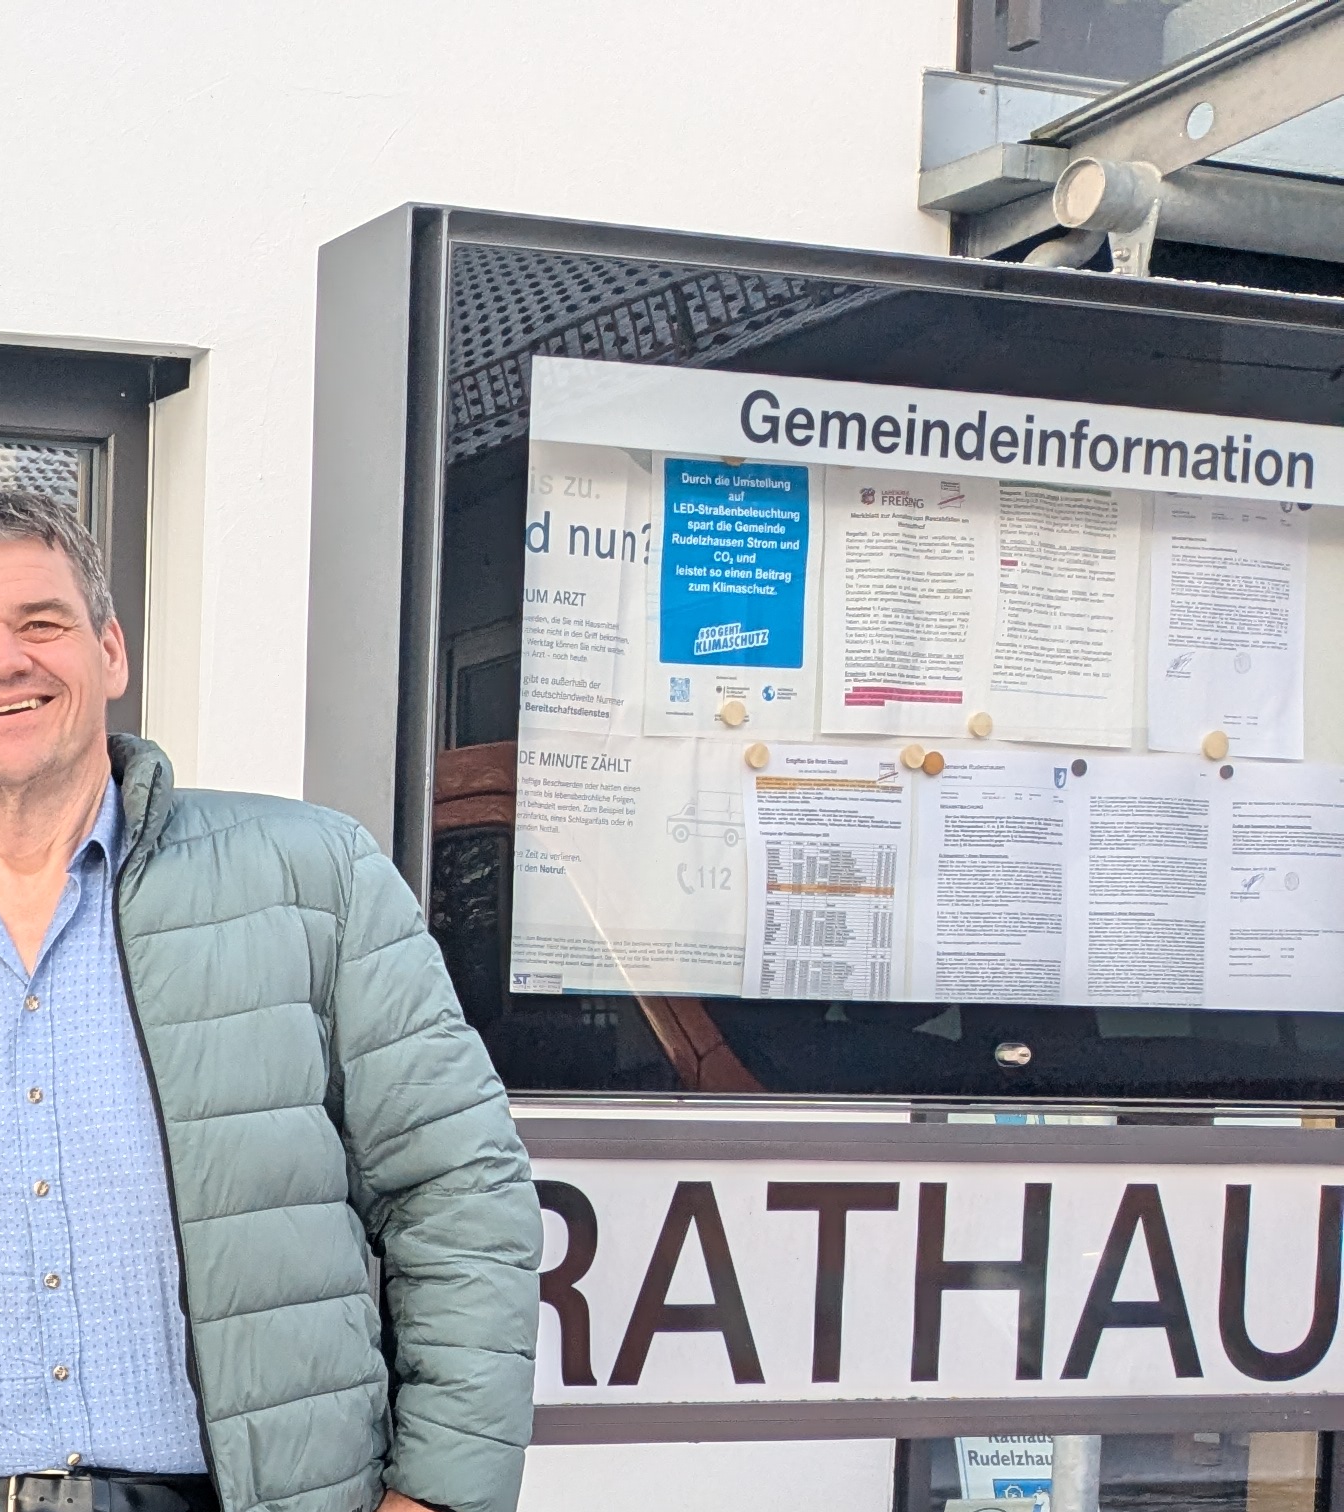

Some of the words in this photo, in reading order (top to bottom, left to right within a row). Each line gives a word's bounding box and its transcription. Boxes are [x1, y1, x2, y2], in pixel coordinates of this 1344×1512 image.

[740, 388, 1314, 489] Gemeindeinformation
[564, 475, 601, 499] zu.
[682, 473, 711, 485] Durch
[715, 475, 730, 485] die
[733, 475, 790, 491] Umstellung
[728, 492, 745, 501] auf
[673, 503, 800, 521] LED-Straßenbeleuchtung
[687, 520, 714, 531] spart
[717, 521, 731, 531] die
[735, 524, 785, 534] Gemeinde
[672, 533, 744, 547] Rudelzhausen
[747, 538, 777, 548] Strom
[780, 540, 800, 550] und
[736, 553, 756, 563] und
[676, 565, 707, 576] leistet
[710, 568, 721, 577] so
[725, 568, 752, 579] einen
[756, 569, 792, 583] Beitrag
[688, 583, 709, 592] zum
[553, 590, 586, 607] ARZT
[695, 630, 768, 654] KLIMASCHUTZ
[539, 752, 588, 770] MINUTE
[591, 753, 631, 773] ZÄHLT
[698, 865, 732, 891] 112
[967, 1450, 1052, 1466] Rudelzhau
